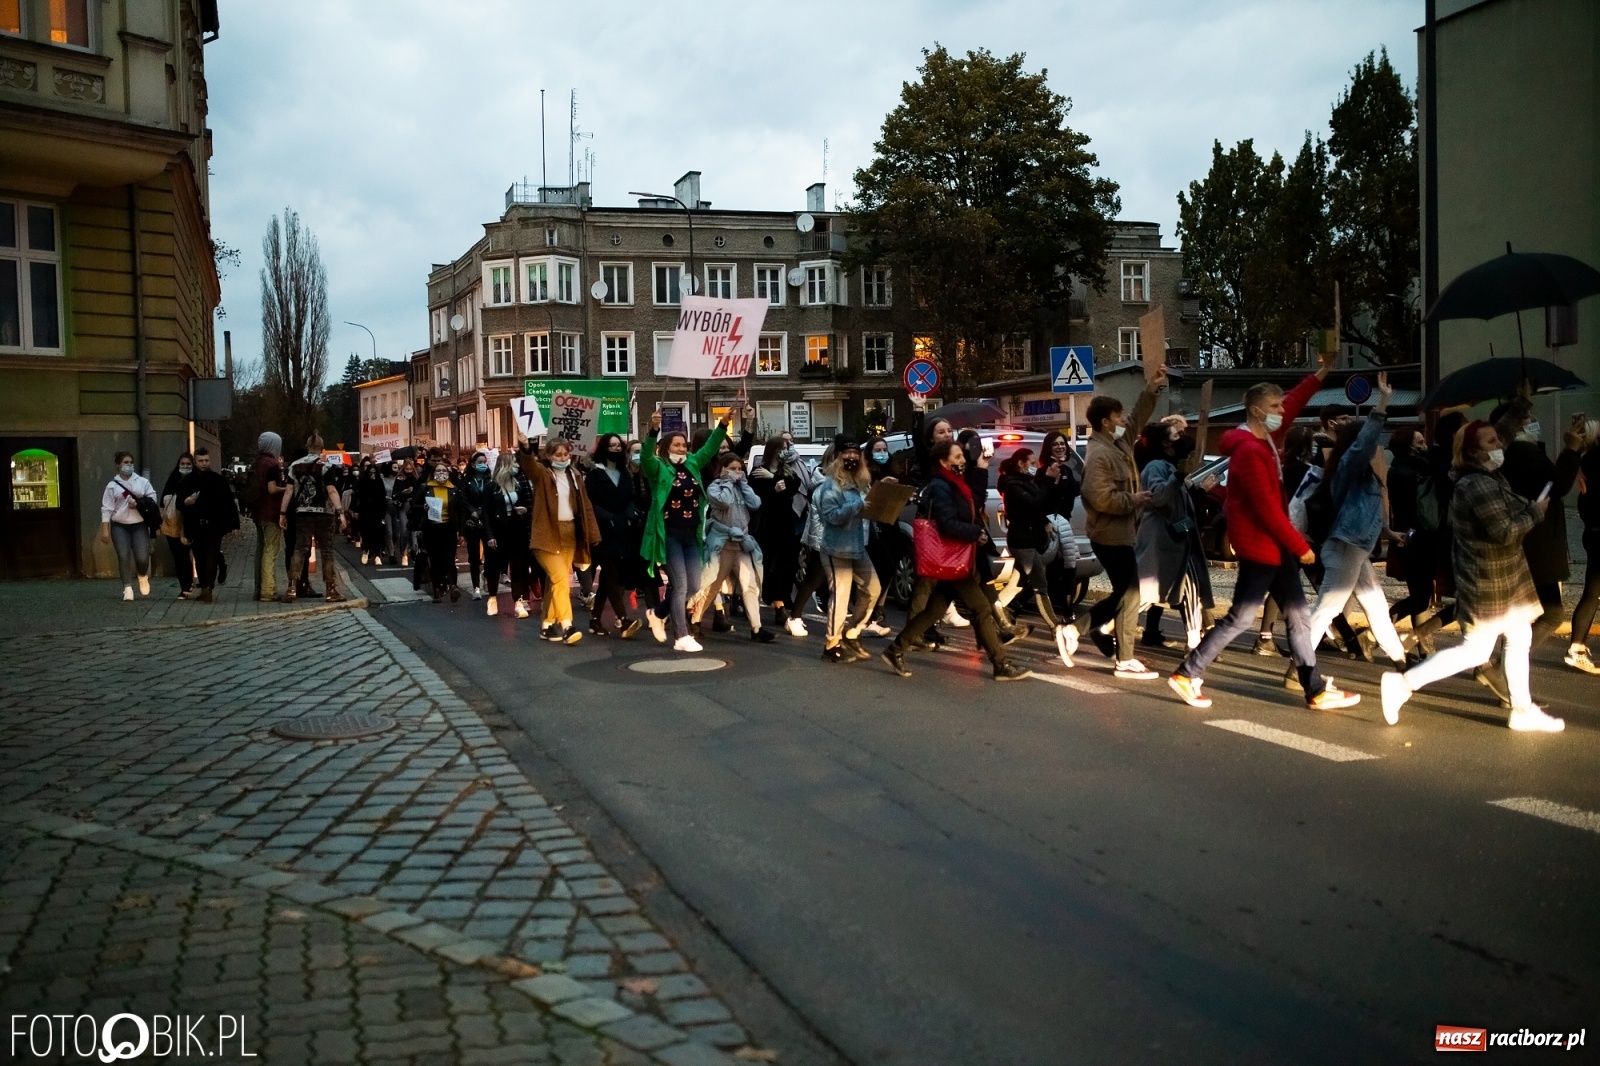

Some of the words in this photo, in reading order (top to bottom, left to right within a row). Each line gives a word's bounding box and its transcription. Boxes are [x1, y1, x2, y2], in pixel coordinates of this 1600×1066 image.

[677, 308, 732, 333] WYBÓR
[702, 335, 727, 356] NIE
[555, 395, 594, 409] OCEAN
[1024, 399, 1060, 415] ATLAS
[562, 407, 586, 418] JEST
